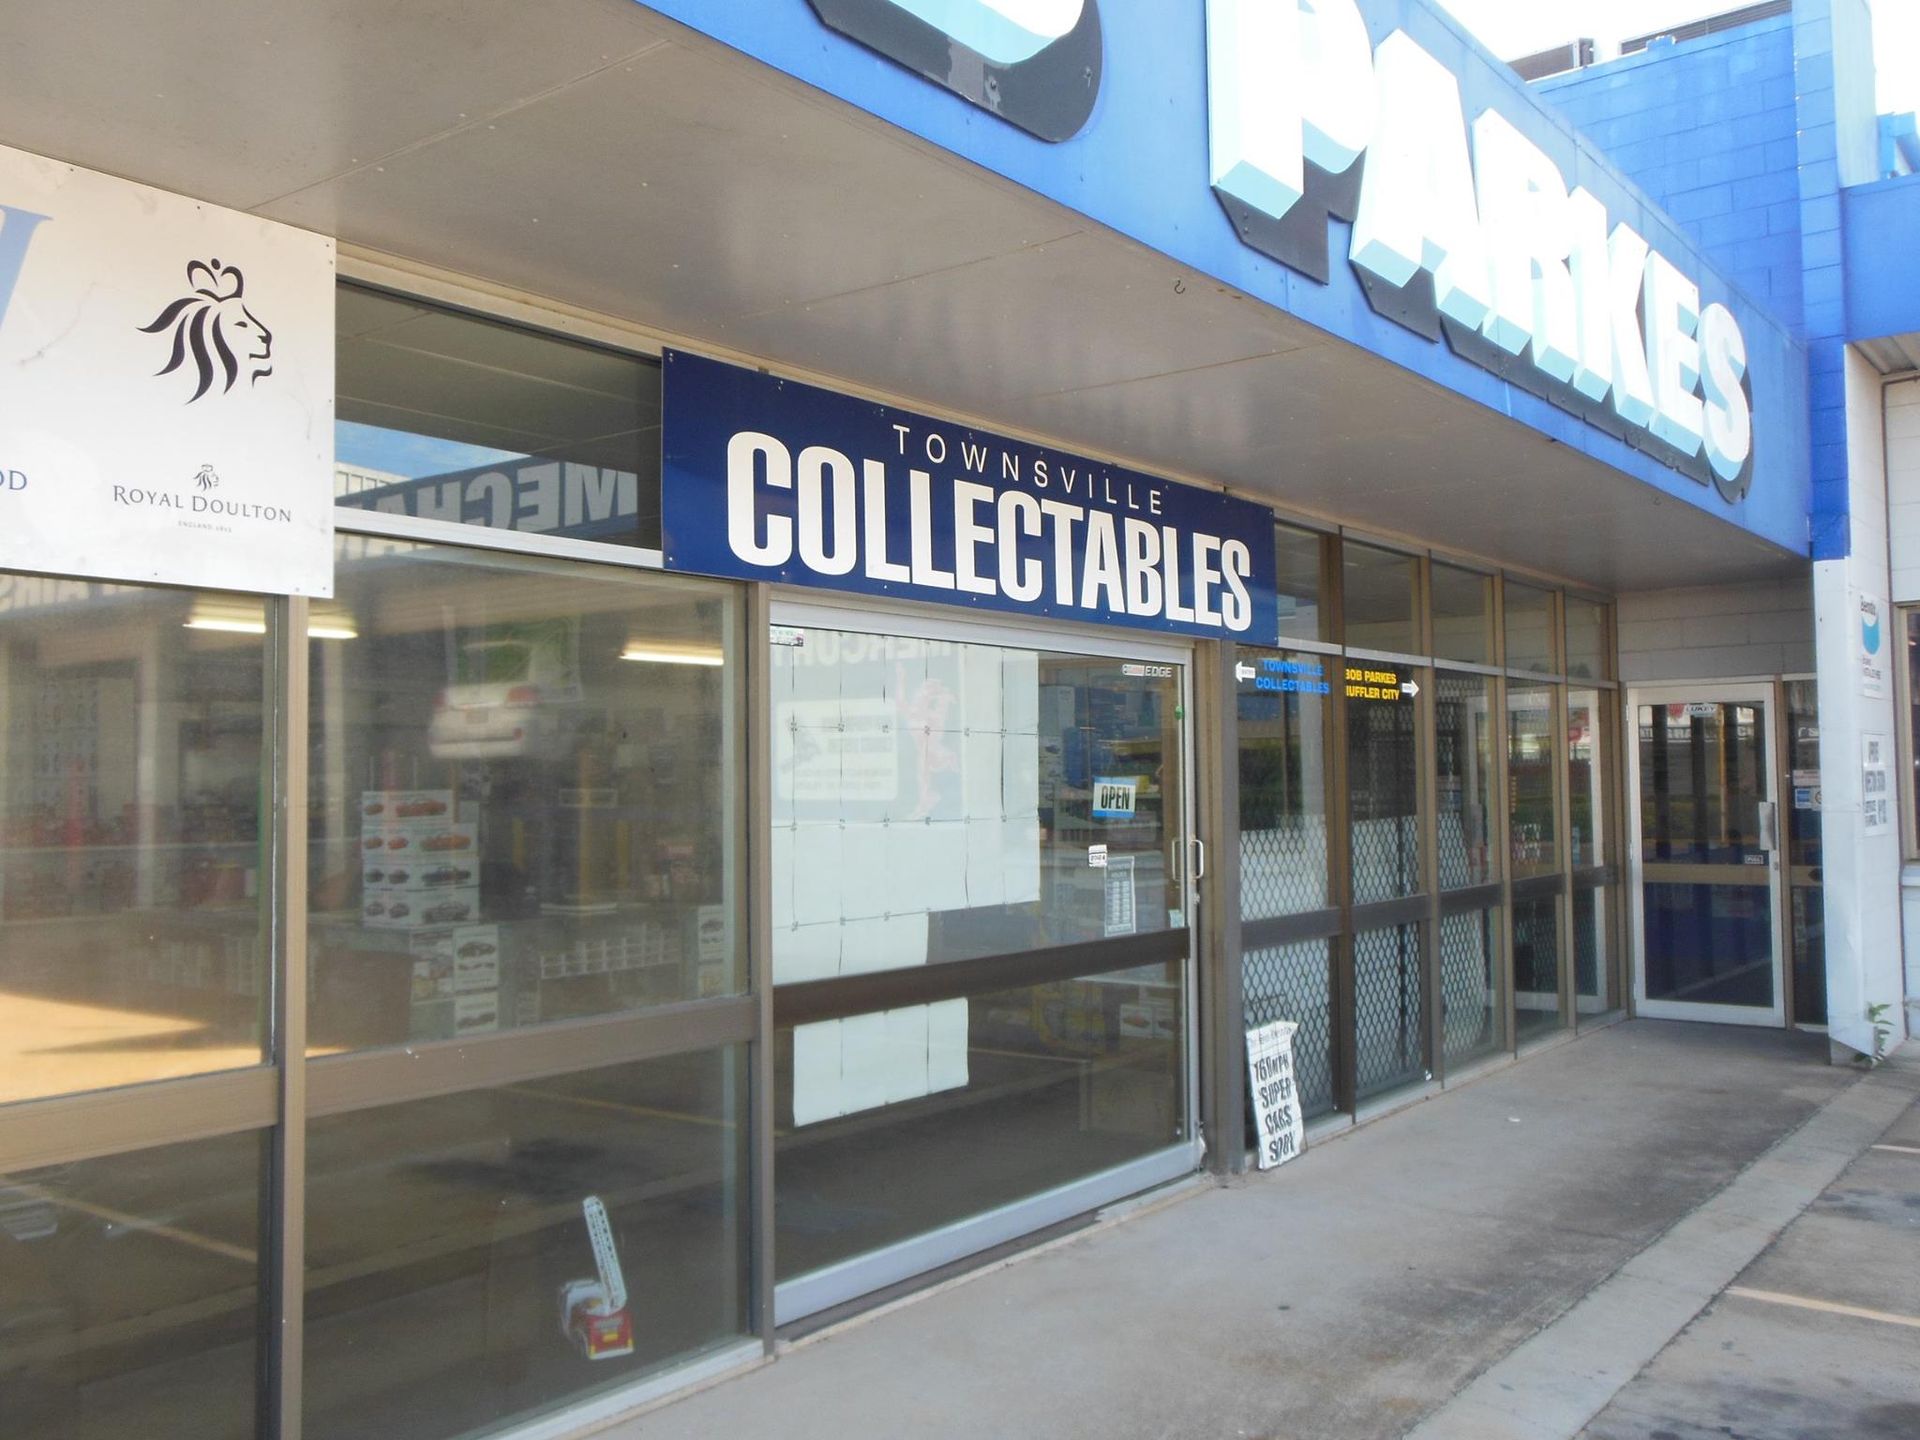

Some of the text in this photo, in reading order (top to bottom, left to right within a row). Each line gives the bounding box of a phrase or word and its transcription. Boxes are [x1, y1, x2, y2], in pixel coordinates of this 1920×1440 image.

[1204, 0, 1752, 482] PARKES
[892, 424, 1163, 515] TOWNSVILLE
[113, 485, 292, 522] ROYAL DOULTON
[727, 431, 1252, 631] COLLECTABLES
[1262, 660, 1324, 677] TOWNSVILLE
[1364, 670, 1397, 684] PARKES
[1255, 677, 1330, 694] COLLECTABLES
[1382, 688, 1400, 700] CITY
[1100, 785, 1130, 810] OPEN
[1259, 1077, 1292, 1108] SUPER
[1265, 1104, 1293, 1136] CARS
